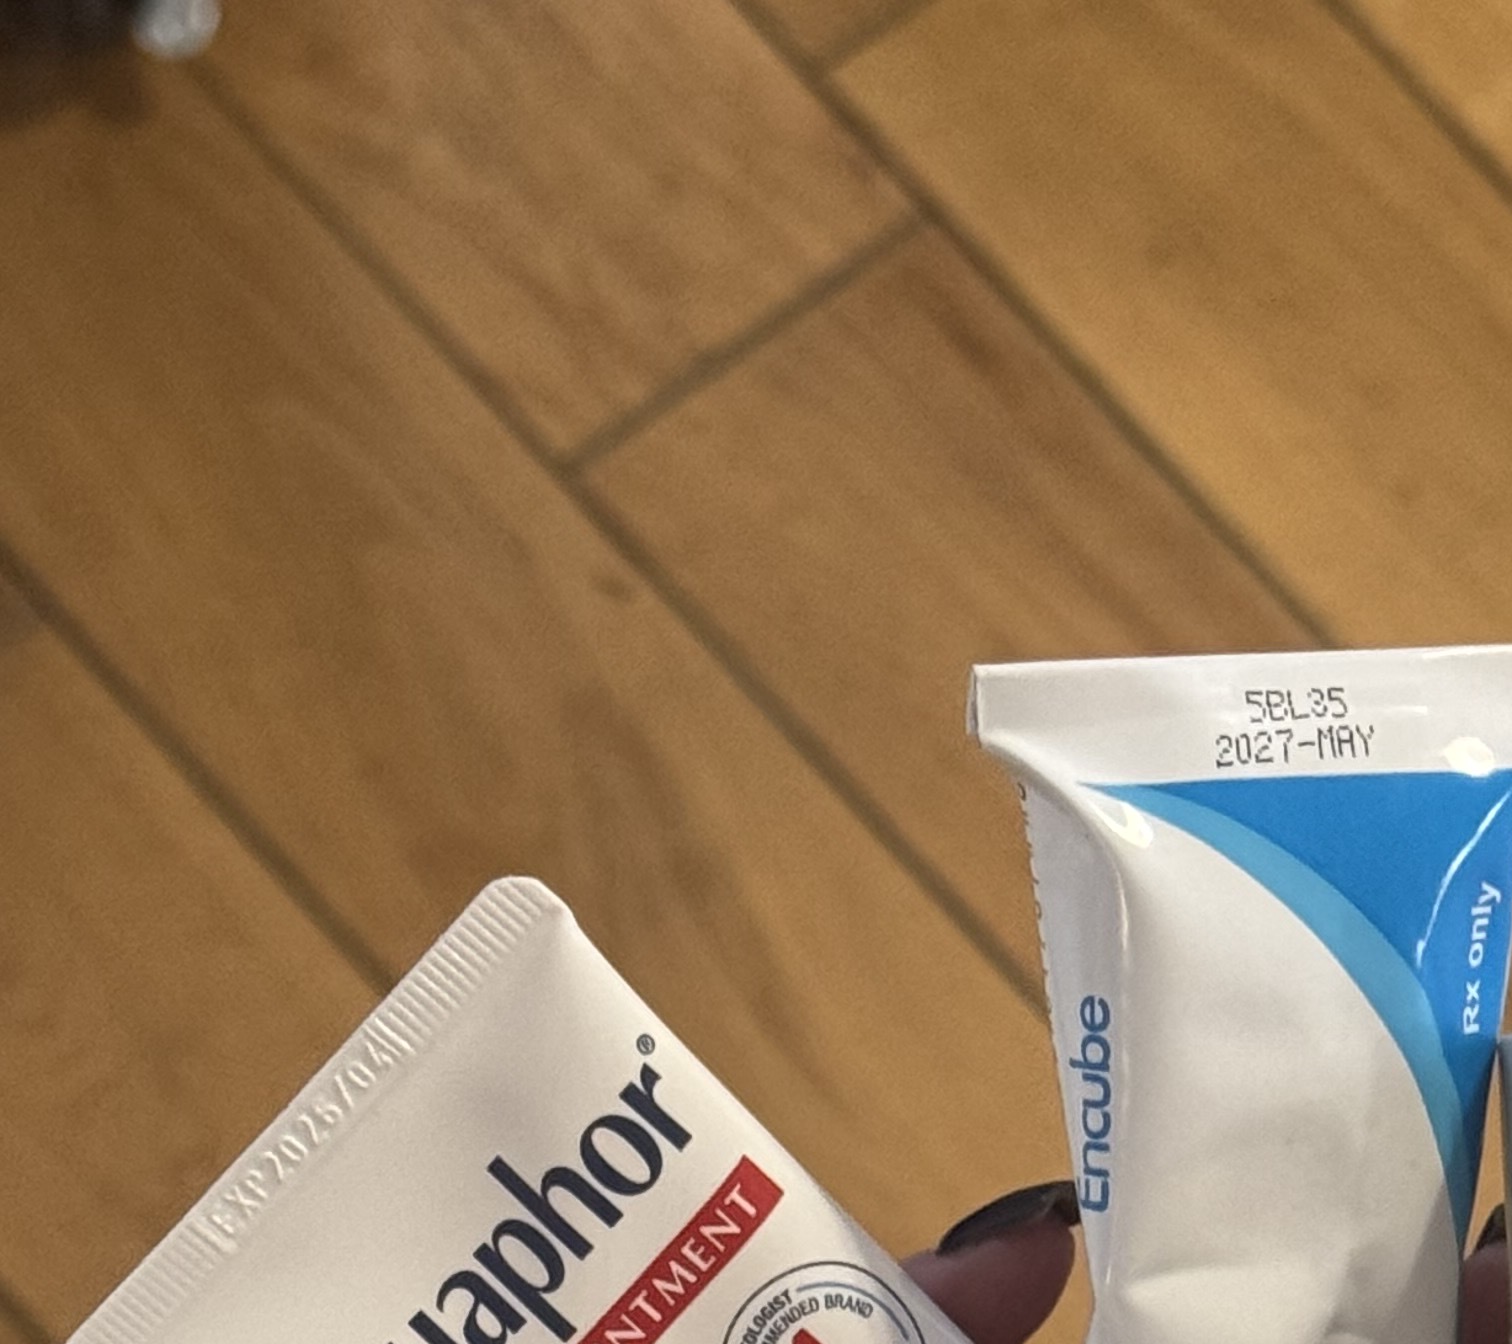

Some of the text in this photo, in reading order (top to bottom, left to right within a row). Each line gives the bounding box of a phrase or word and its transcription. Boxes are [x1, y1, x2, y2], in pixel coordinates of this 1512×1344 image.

[1244, 686, 1348, 723] 5BL35
[1215, 725, 1375, 768] 2027-MAY
[1462, 881, 1502, 1036] Rx only
[1068, 995, 1112, 1213] Encube
[824, 1293, 874, 1319] BRAND
